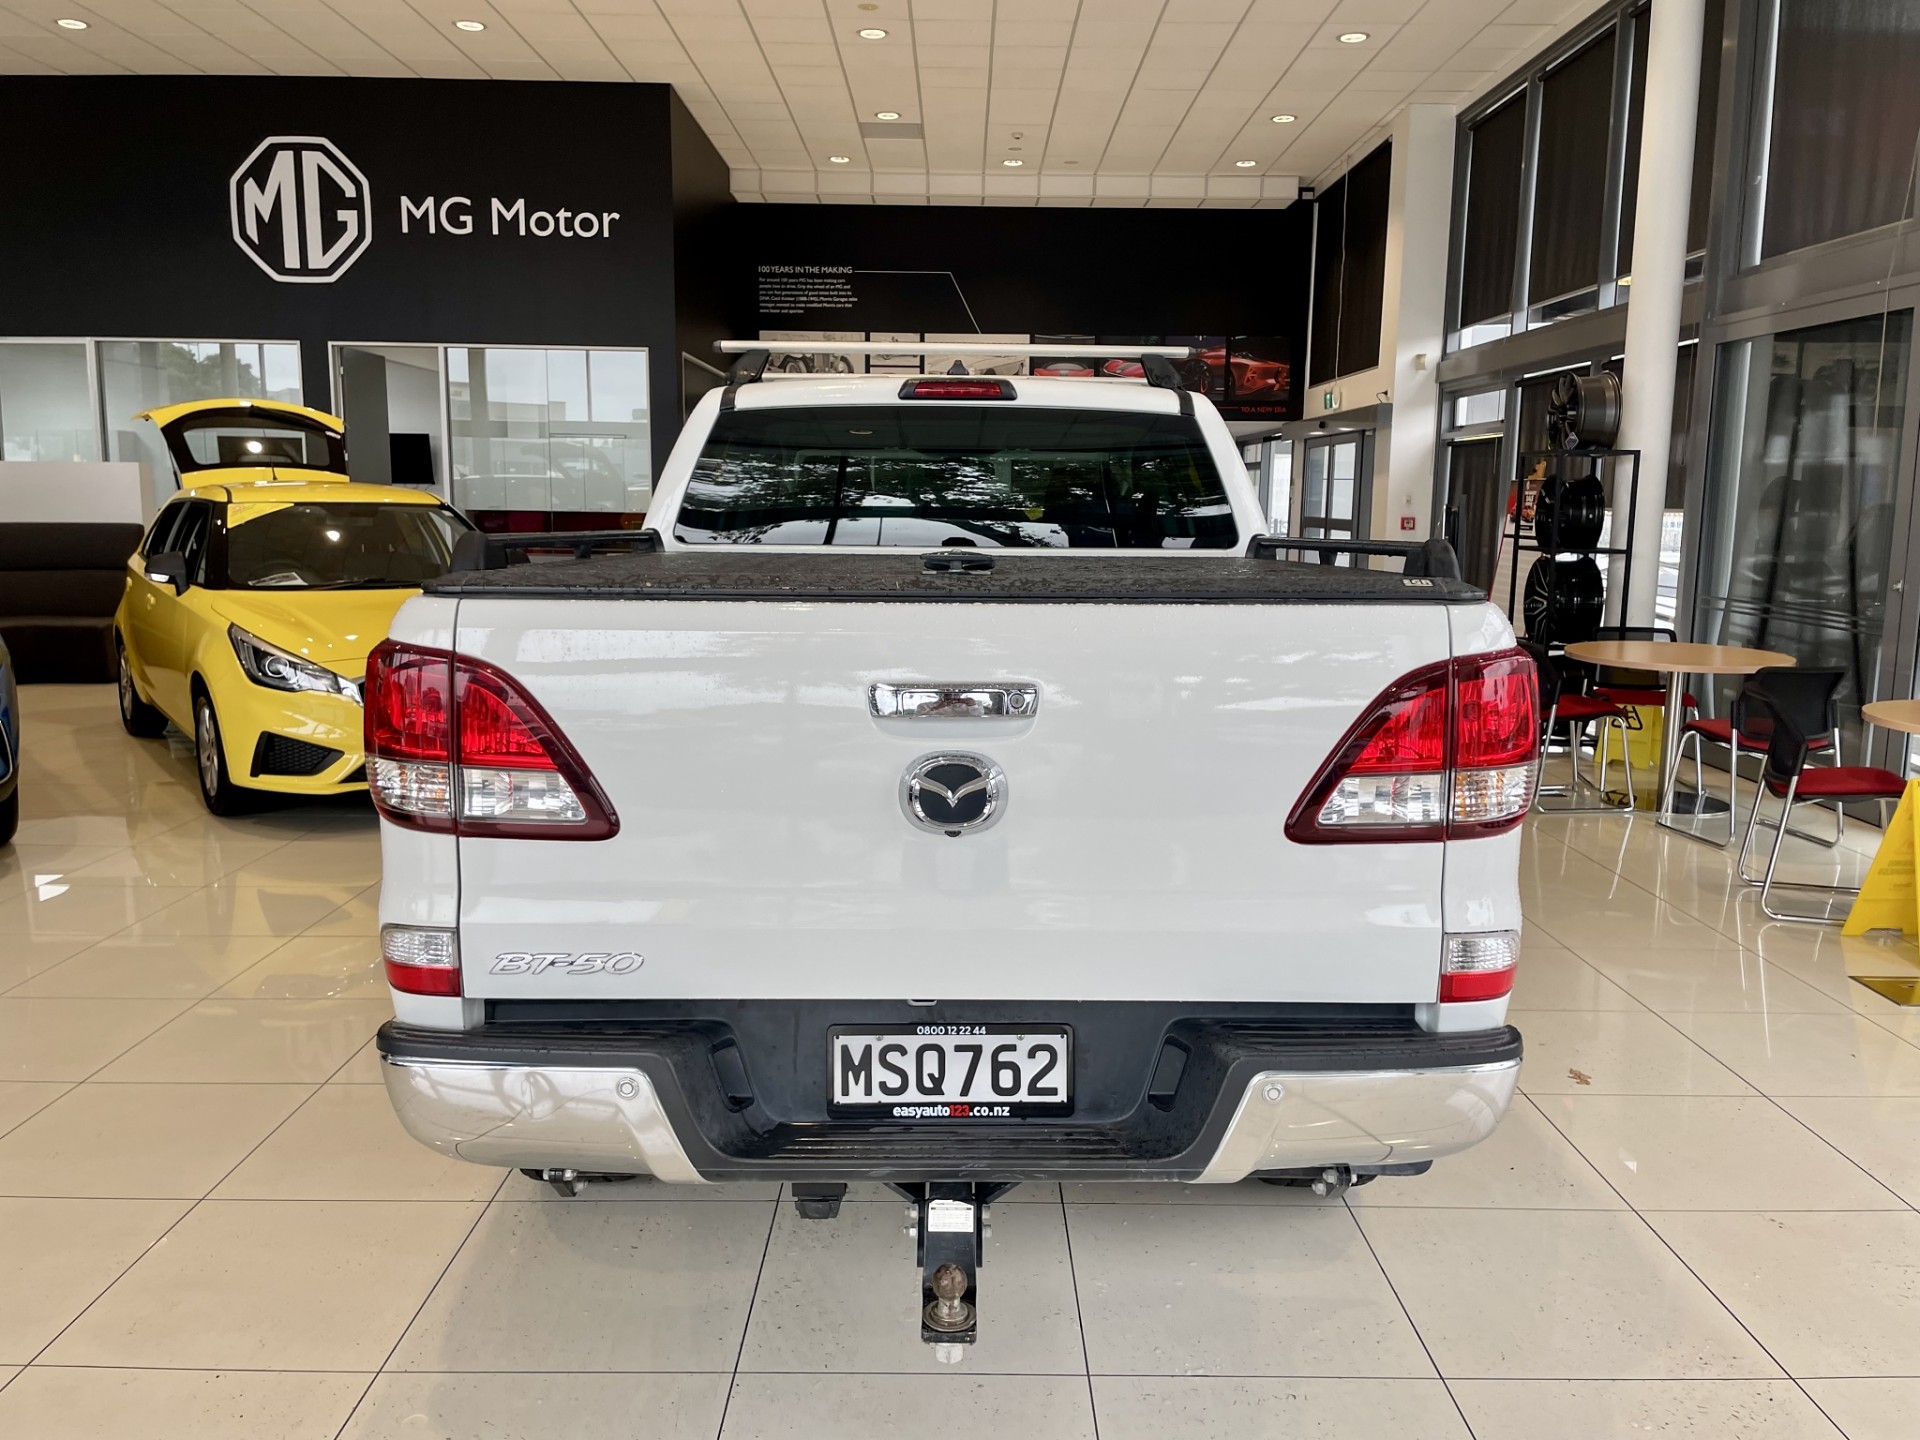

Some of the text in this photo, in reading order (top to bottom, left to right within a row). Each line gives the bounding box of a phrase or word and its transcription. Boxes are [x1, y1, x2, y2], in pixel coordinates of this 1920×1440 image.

[241, 148, 360, 271] MG
[400, 195, 620, 238] MG Motor
[758, 265, 853, 275] 100 YEARS IN THE MAKING
[489, 951, 645, 975] BT-50
[916, 1026, 987, 1035] 0800 12 22 44
[840, 1043, 1059, 1097] MSQ762
[892, 1104, 1011, 1119] easyauto123.co.nz
